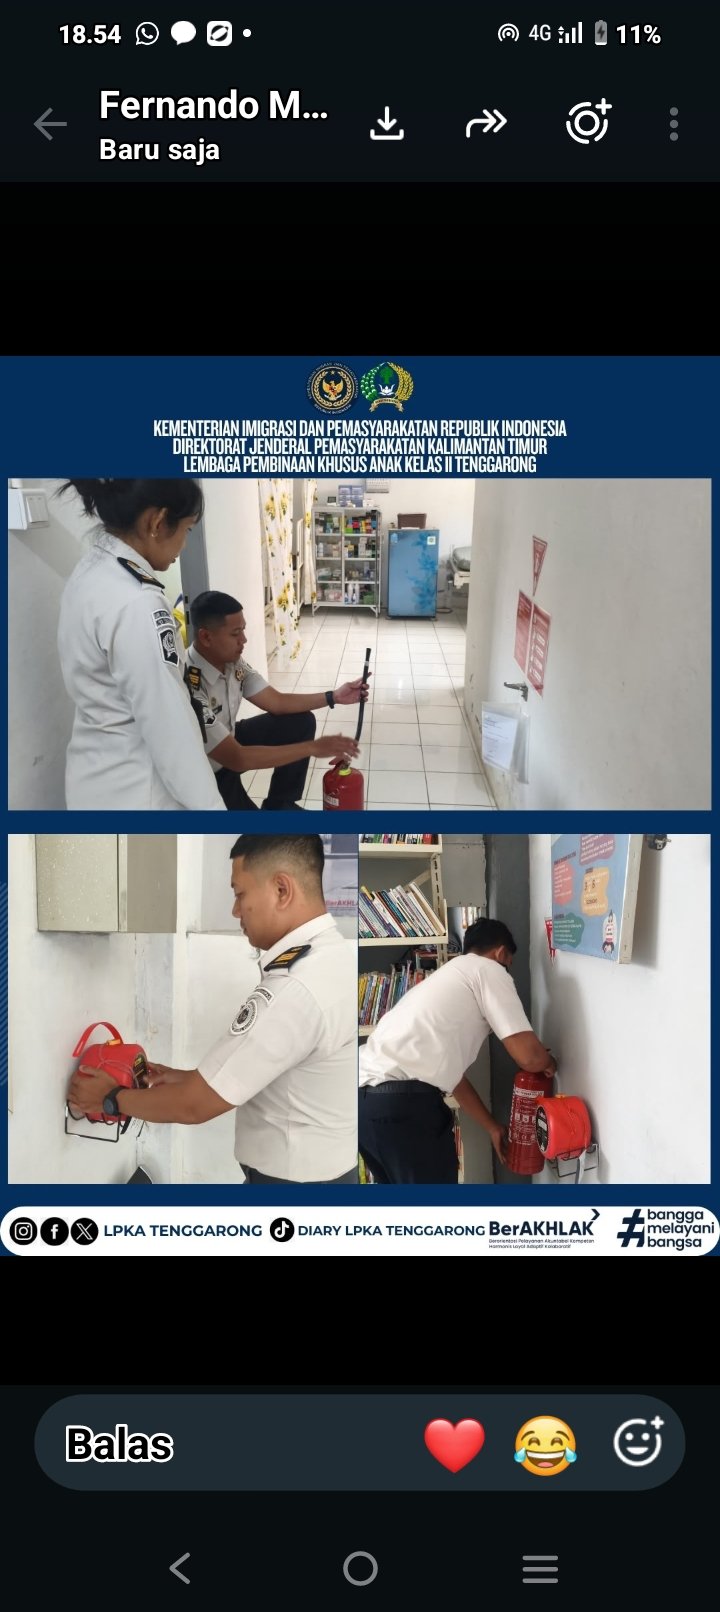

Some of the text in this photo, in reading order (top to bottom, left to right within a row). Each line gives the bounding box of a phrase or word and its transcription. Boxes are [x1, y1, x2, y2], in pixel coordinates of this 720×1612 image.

[59, 24, 122, 44] 18.54
[528, 24, 551, 41] 4G
[616, 24, 662, 44] 11%
[100, 88, 259, 120] Fernando
[100, 137, 220, 166] Baru saja
[66, 1424, 174, 1463] Balas
